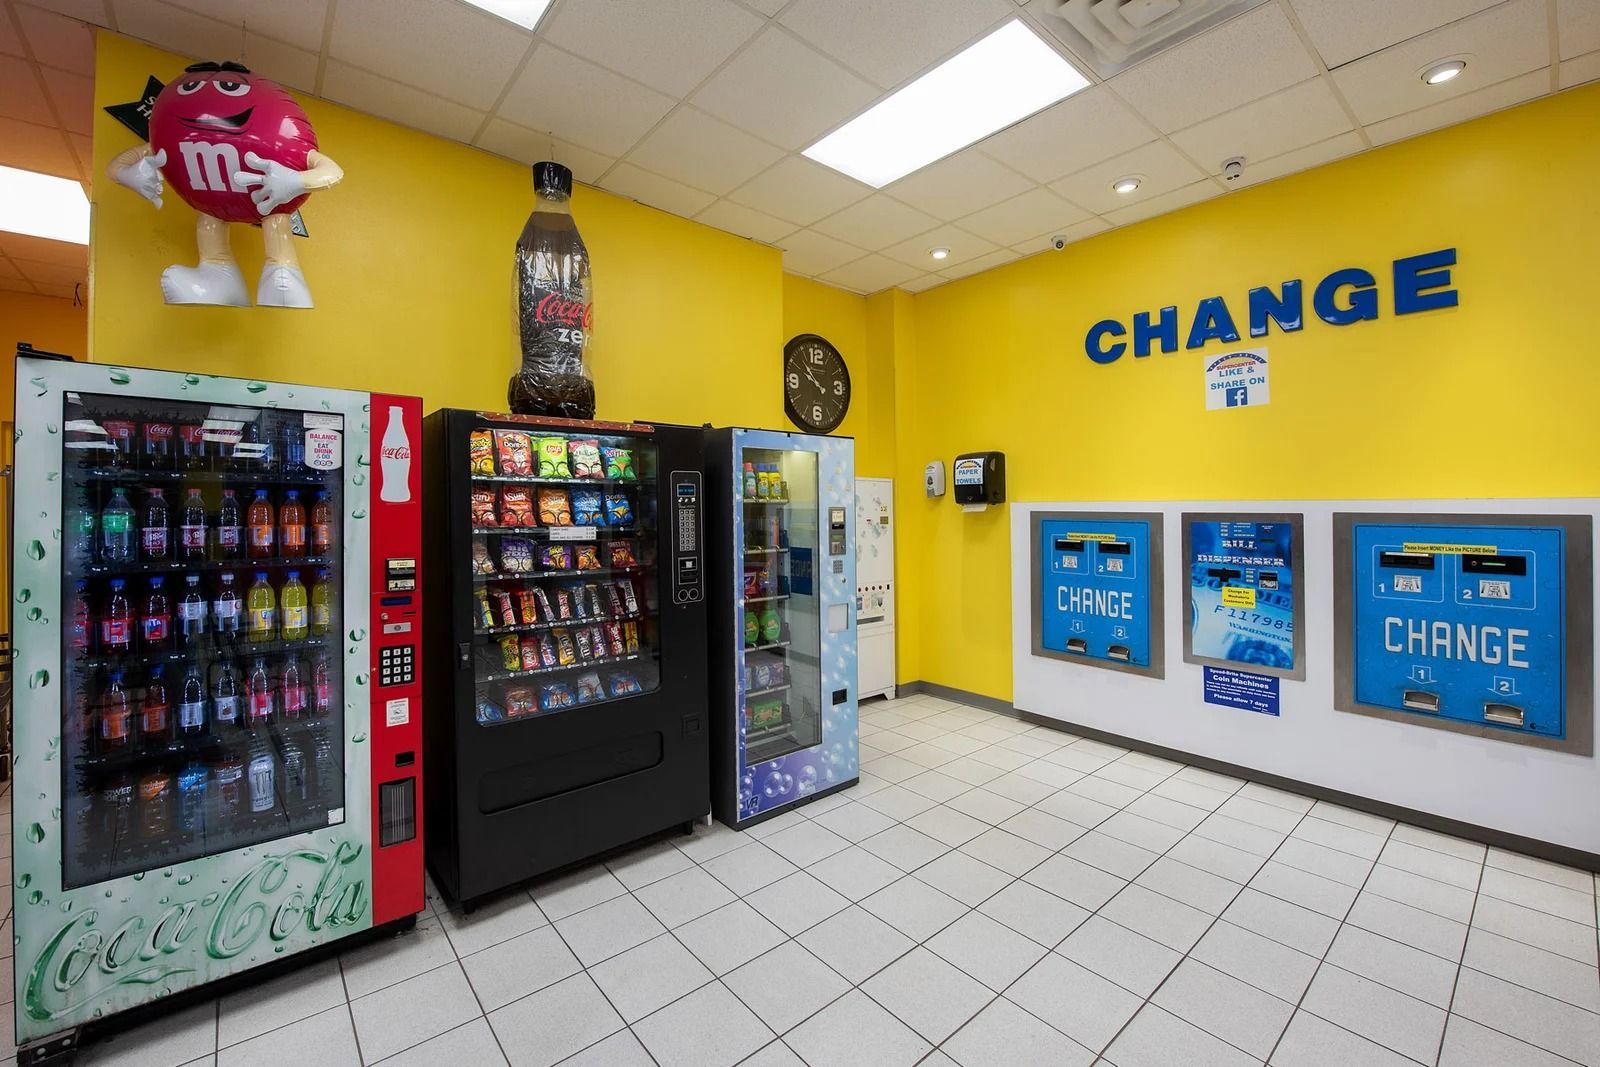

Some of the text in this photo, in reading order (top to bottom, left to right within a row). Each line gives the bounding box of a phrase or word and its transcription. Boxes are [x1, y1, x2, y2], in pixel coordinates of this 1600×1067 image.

[1085, 248, 1459, 364] CHANGE
[808, 347, 824, 365] 12
[1219, 366, 1255, 377] LIKE &
[789, 373, 799, 389] 9
[1210, 376, 1265, 390] SHARE ON
[833, 380, 843, 396] 3
[812, 405, 823, 421] 6
[309, 433, 338, 441] BALANCE
[1222, 540, 1257, 549] BILL
[1055, 561, 1059, 569] 1
[1197, 554, 1285, 567] DISPENSER
[1098, 564, 1104, 573] 2
[1378, 583, 1386, 593] 1
[1462, 589, 1473, 600] 2
[1058, 586, 1133, 620] CHANGE
[1075, 623, 1081, 631] 1
[1117, 629, 1124, 637] 2
[1384, 616, 1530, 669] CHANGE
[1418, 670, 1424, 679] 1
[1213, 674, 1230, 682] Coin
[1231, 677, 1270, 690] Machines
[1499, 681, 1510, 691] 2
[1213, 693, 1233, 701] Please
